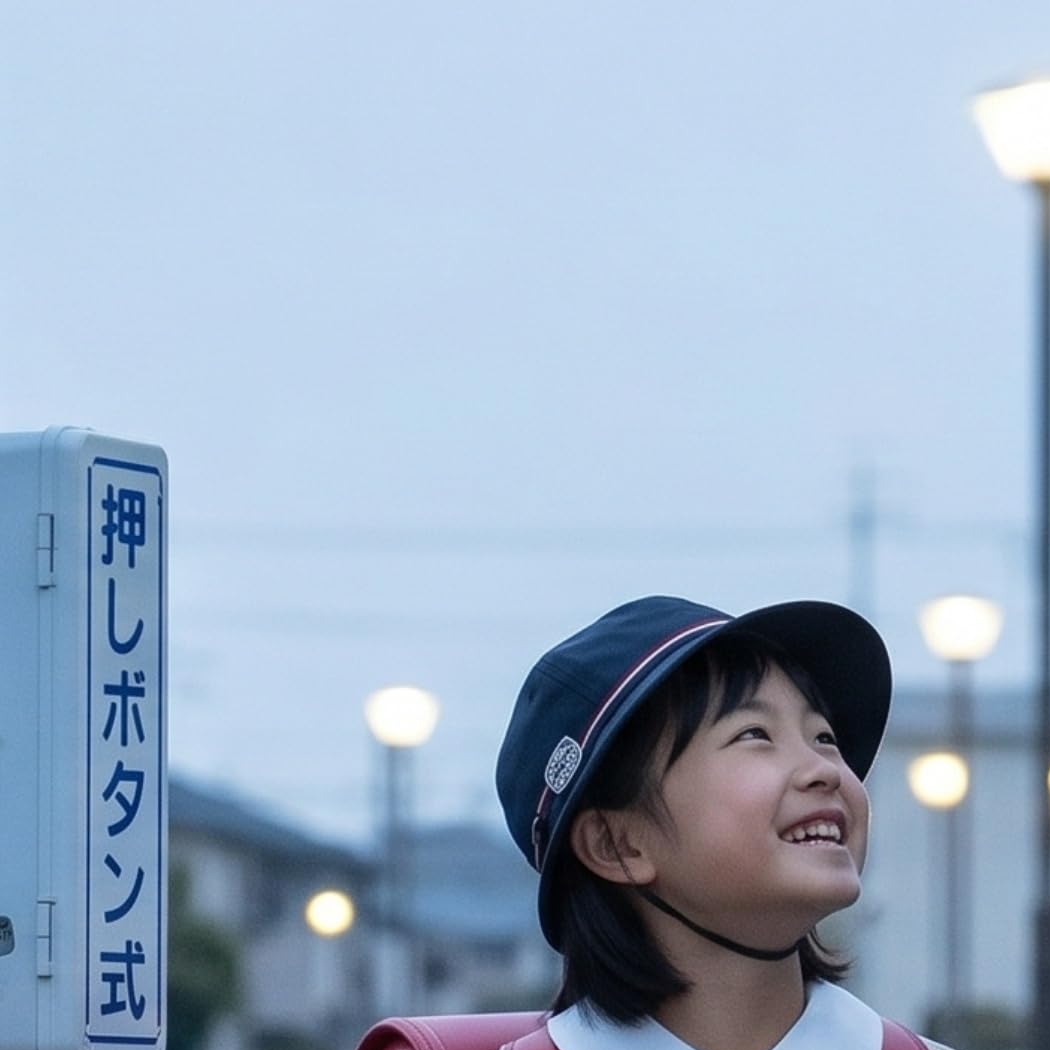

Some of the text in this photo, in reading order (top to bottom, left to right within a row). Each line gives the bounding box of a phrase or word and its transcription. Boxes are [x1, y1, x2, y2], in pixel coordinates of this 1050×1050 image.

[100, 483, 146, 1021] 押しボタン式
